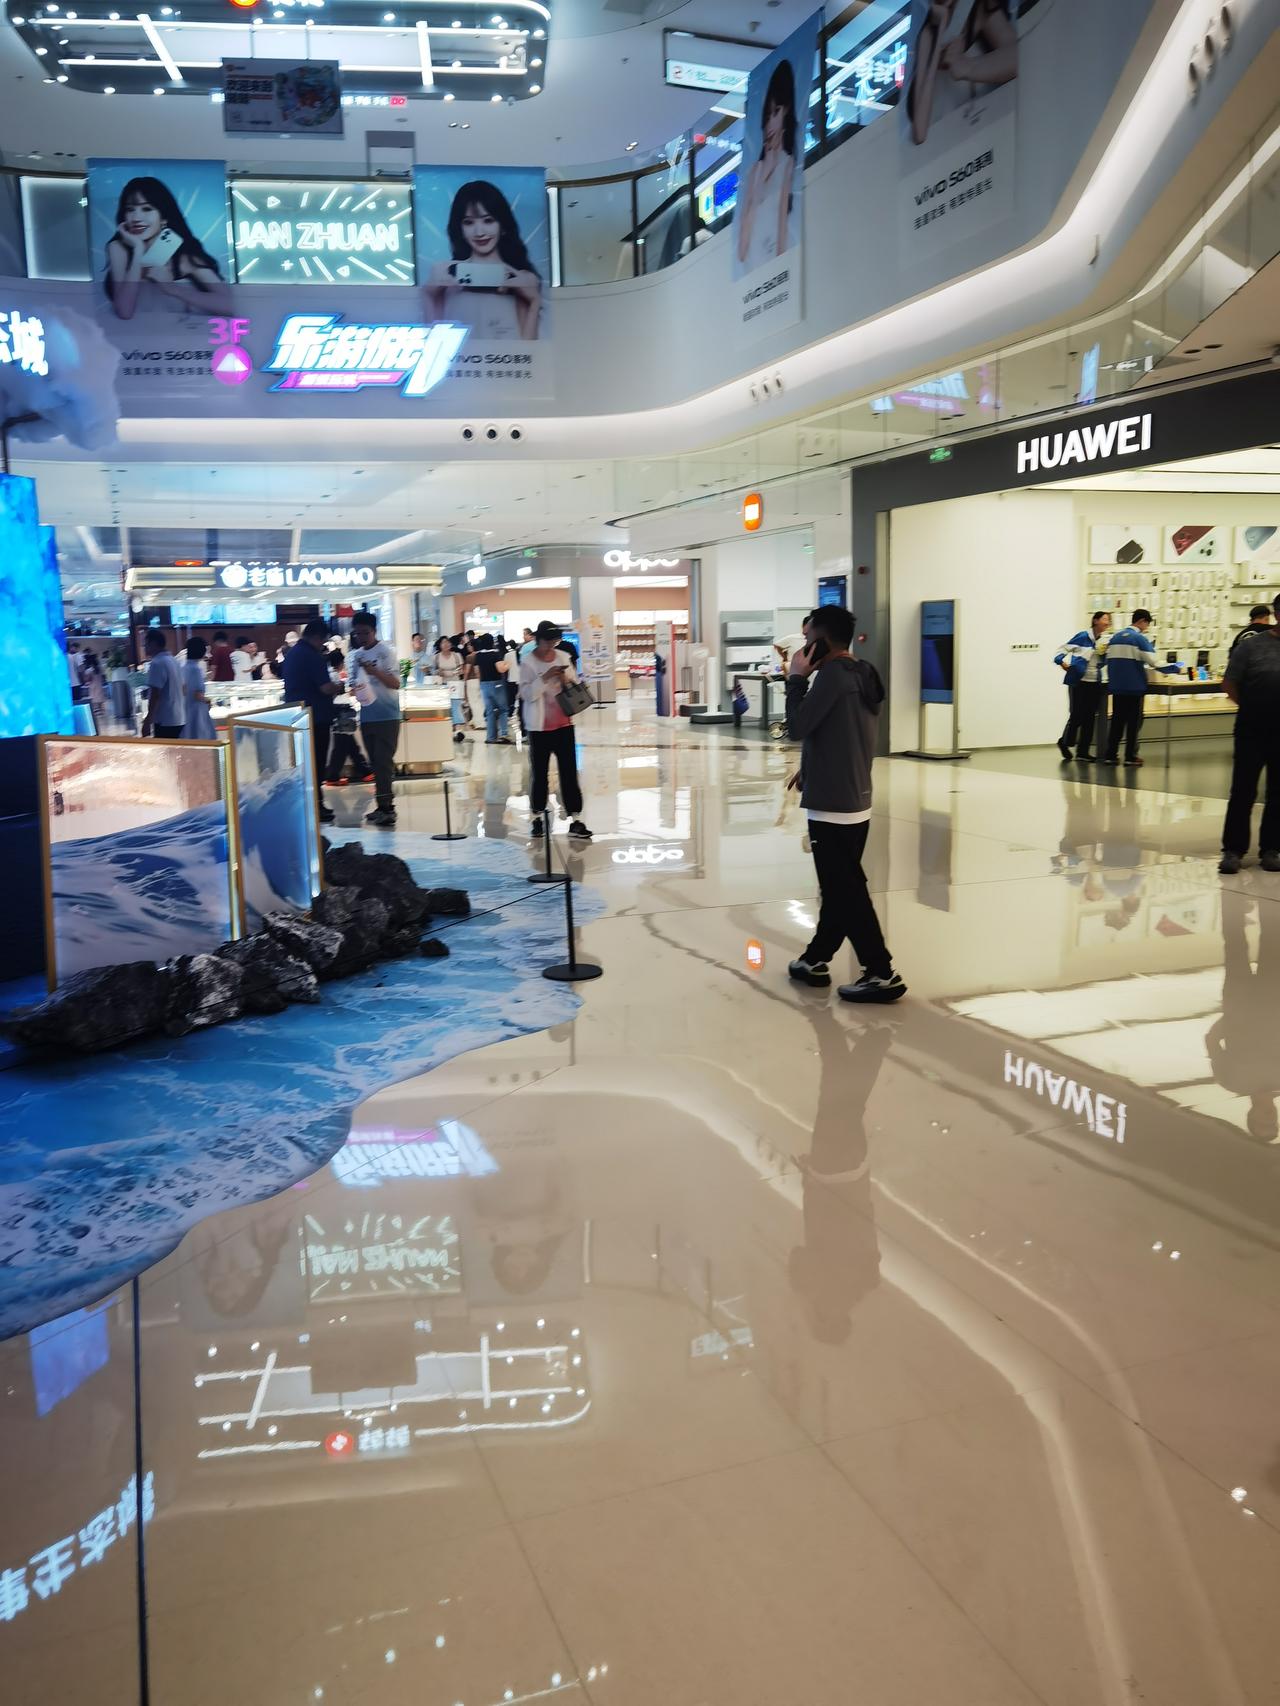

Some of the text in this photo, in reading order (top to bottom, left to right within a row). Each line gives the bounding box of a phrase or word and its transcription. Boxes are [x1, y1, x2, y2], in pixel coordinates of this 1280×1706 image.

[914, 179, 948, 206] vivo
[295, 221, 400, 251] ZHUAN
[208, 318, 250, 344] 3F
[121, 350, 162, 361] vivo
[1017, 413, 1152, 474] HUAWEI
[286, 567, 374, 586] LAOMIAO
